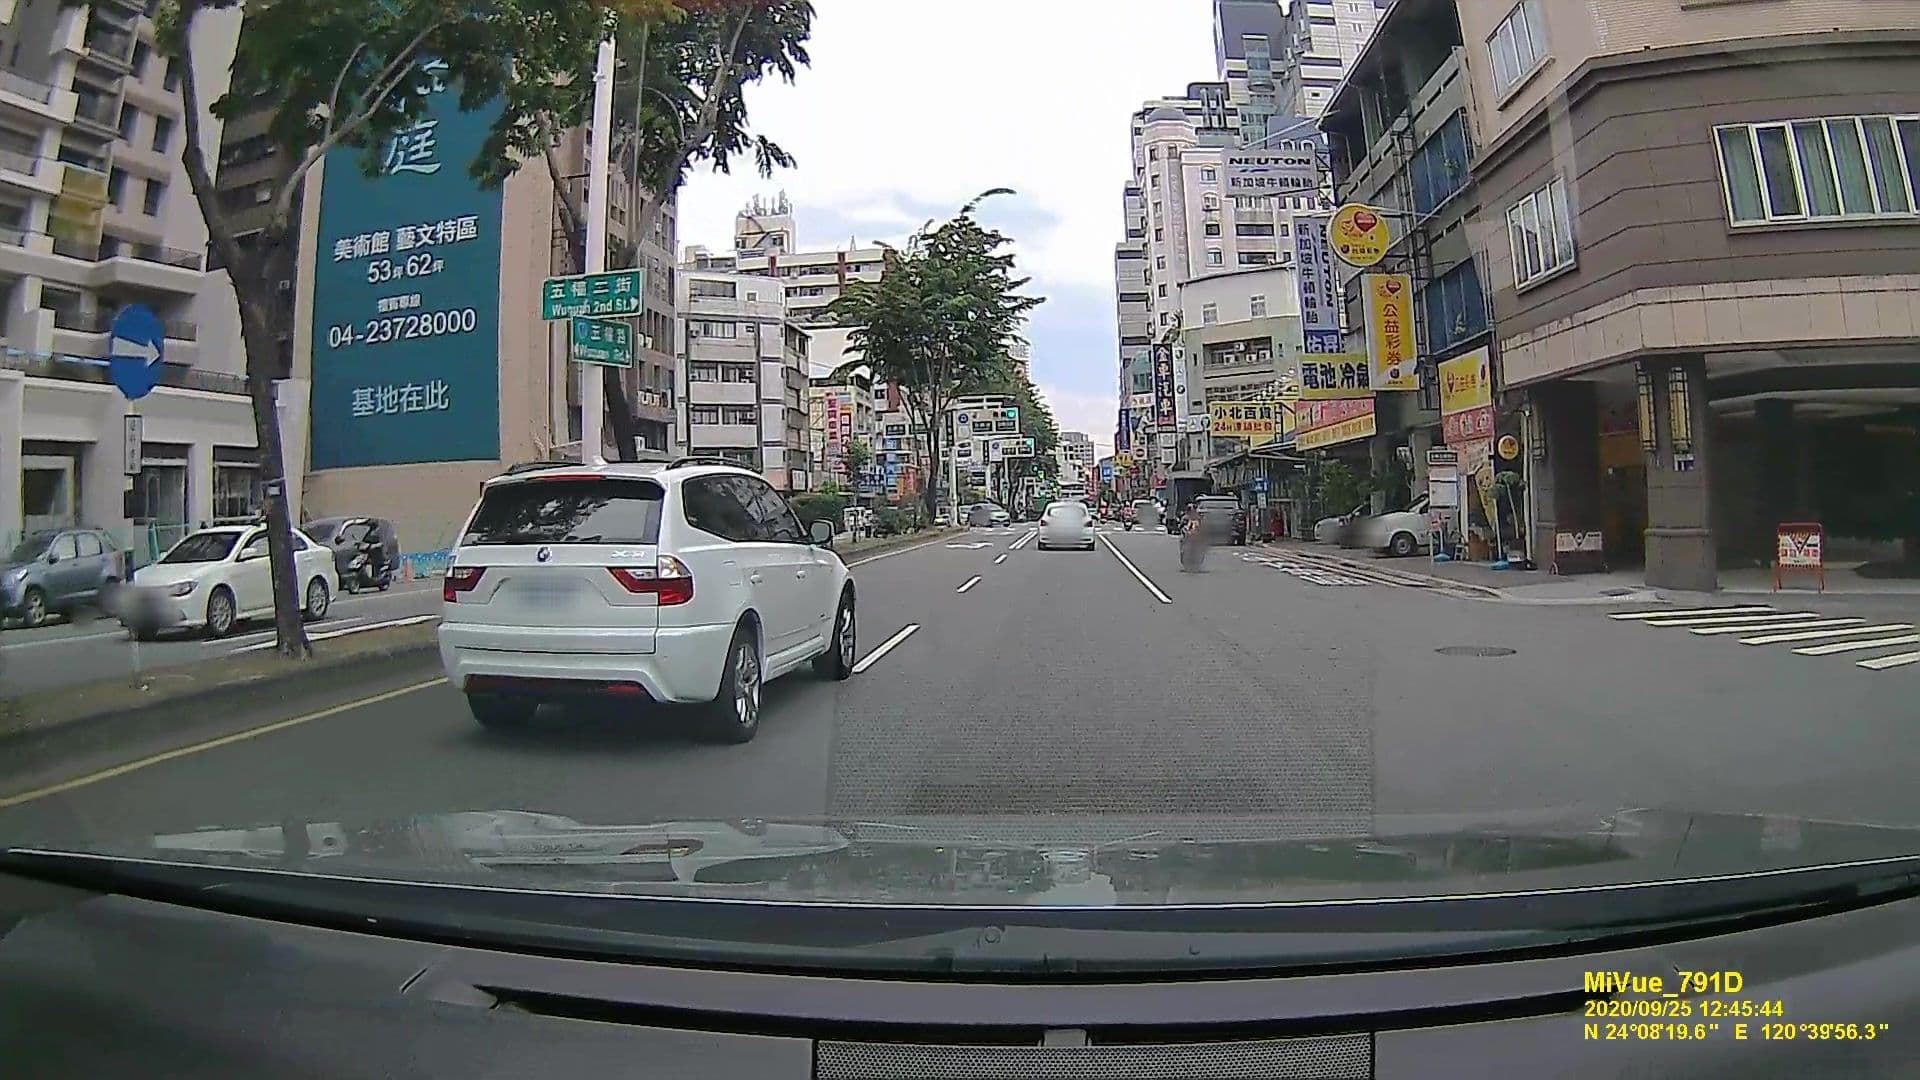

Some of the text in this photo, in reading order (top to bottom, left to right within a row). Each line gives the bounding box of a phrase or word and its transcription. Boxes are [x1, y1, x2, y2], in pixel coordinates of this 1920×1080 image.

[1229, 157, 1311, 165] NEUTON
[334, 215, 479, 261] 美術館 藝文特區
[593, 299, 612, 313] 2nd
[329, 308, 476, 348] 04-23728000
[1383, 303, 1401, 366] 公益彩券
[351, 379, 450, 417] 基地在此
[1214, 406, 1272, 420] 小北百貨
